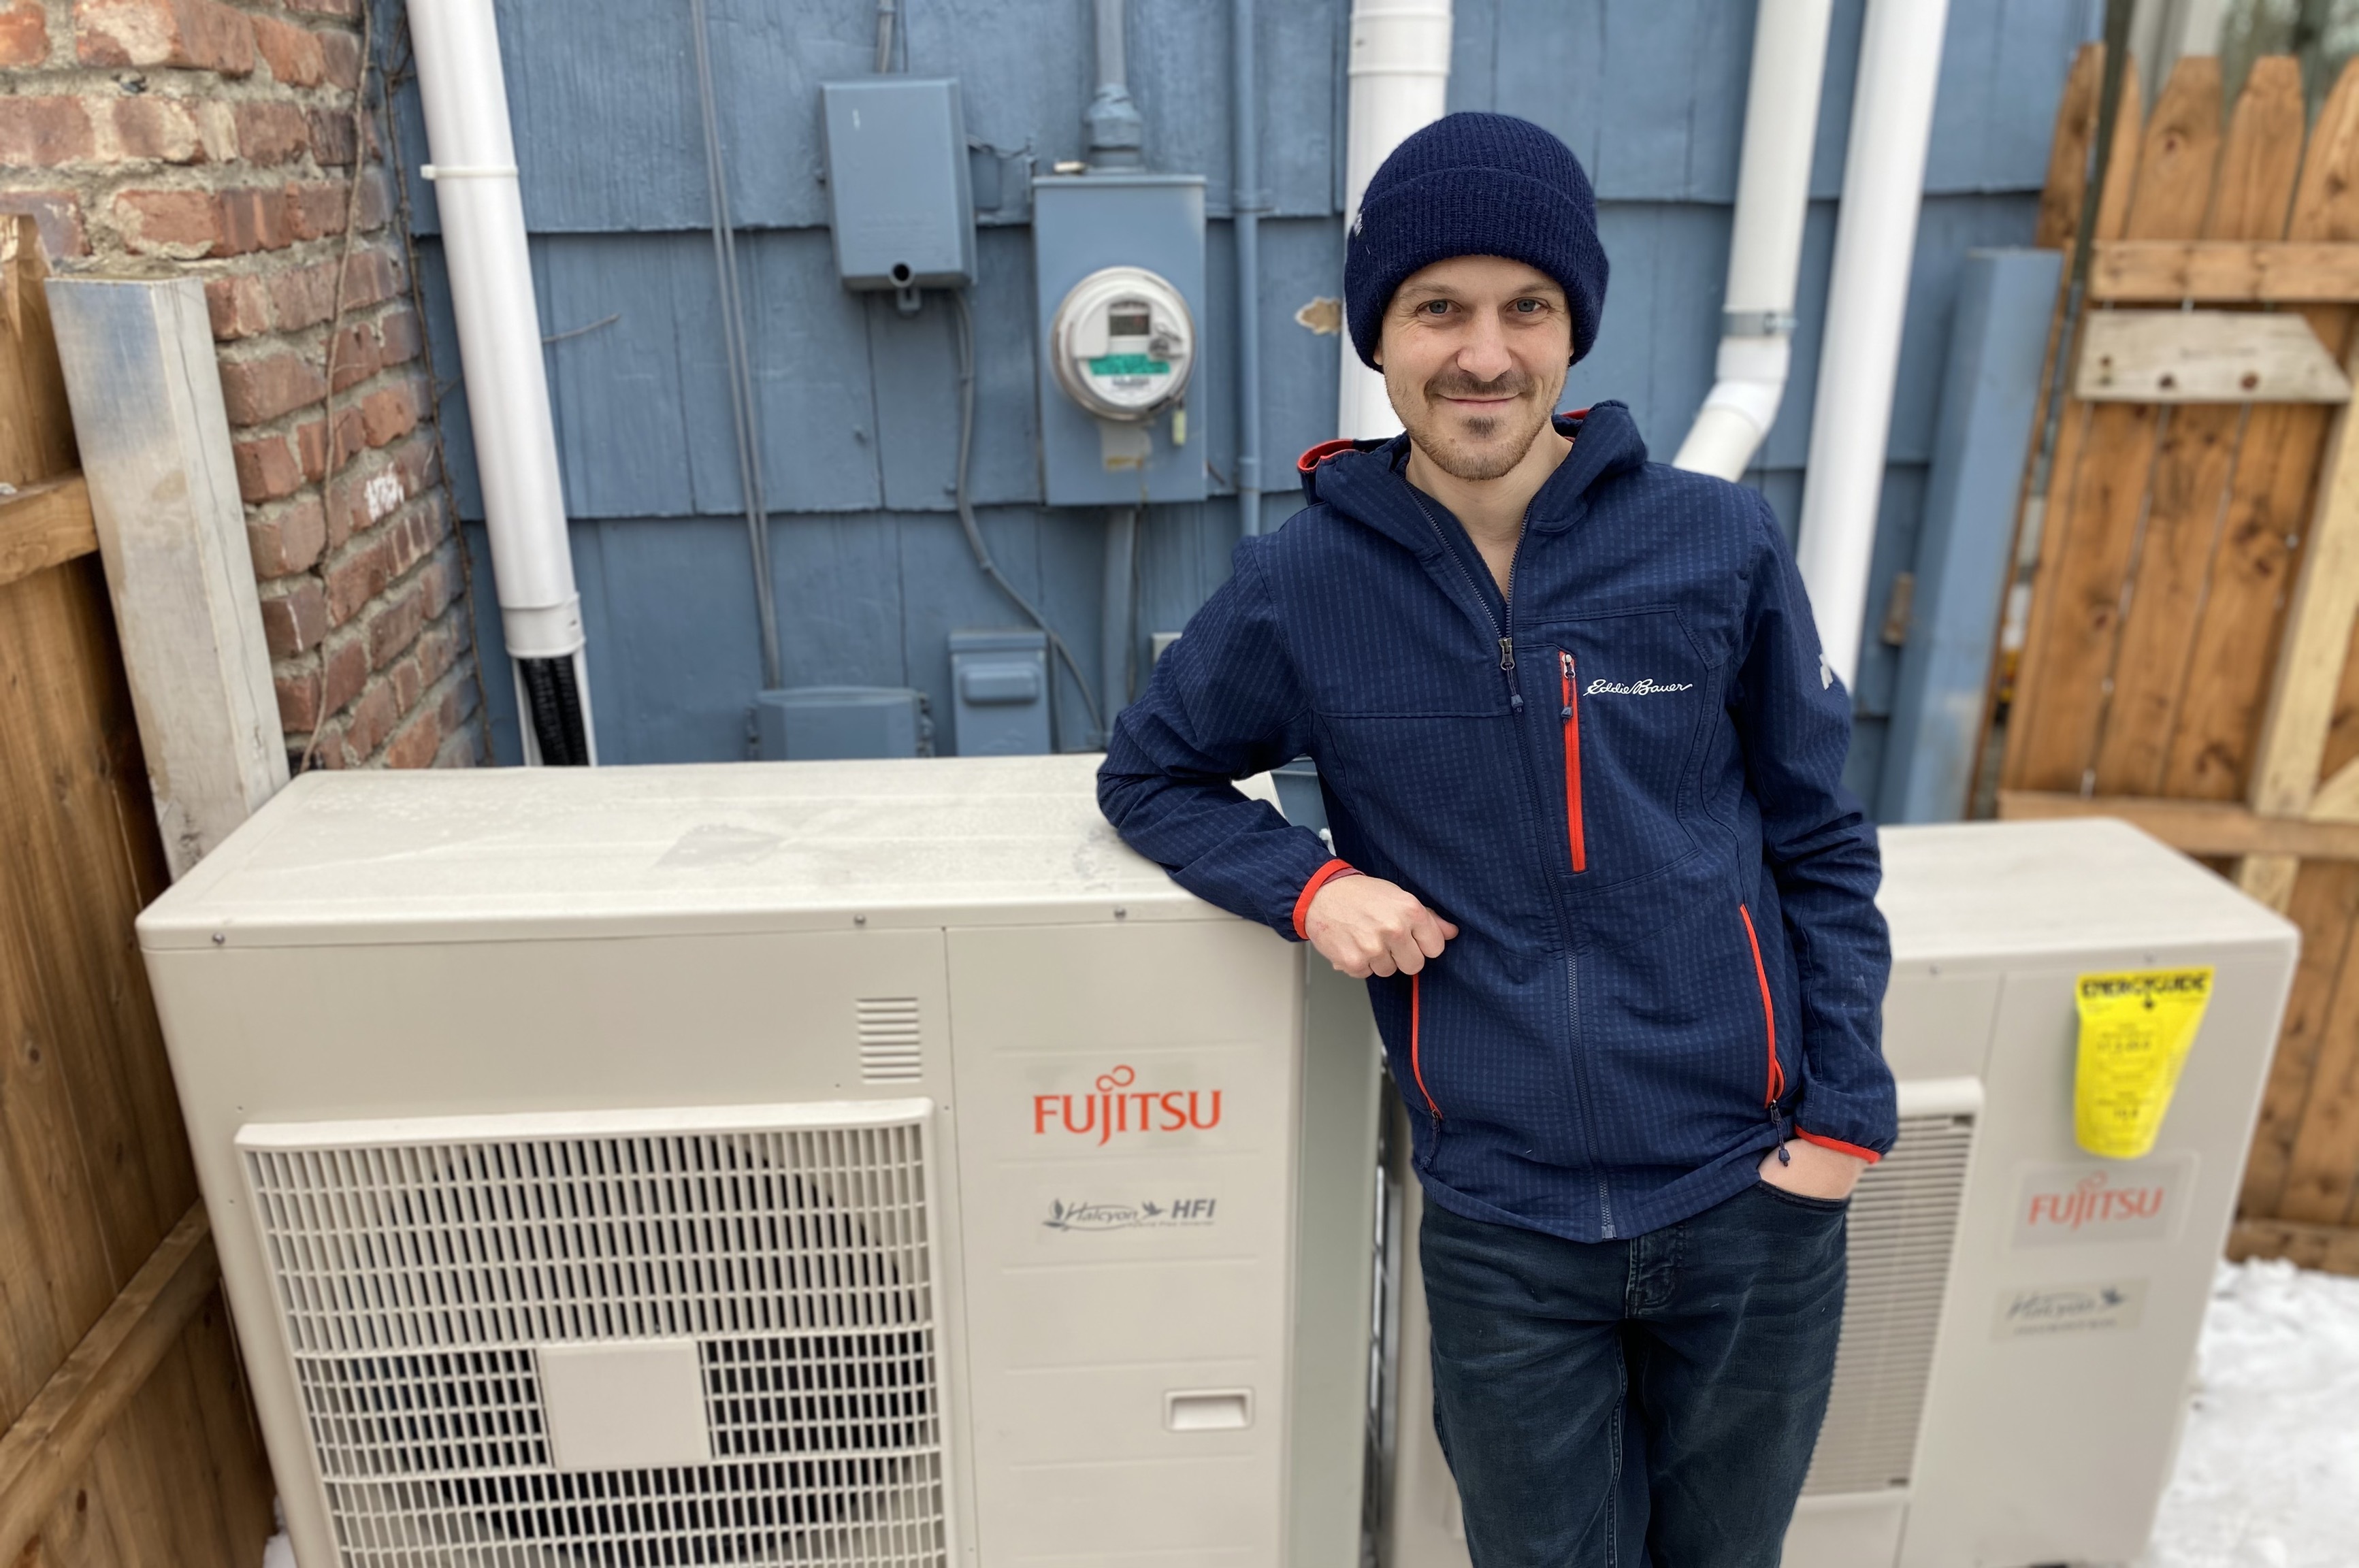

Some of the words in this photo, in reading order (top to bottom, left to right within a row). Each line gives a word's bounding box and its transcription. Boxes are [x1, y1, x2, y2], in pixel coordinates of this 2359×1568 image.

[1583, 679, 1633, 696] Eddie
[1633, 679, 1693, 696] Bauer
[1033, 1064, 1222, 1147] FUJITSU
[1064, 1202, 1139, 1223] Halcyon
[1171, 1198, 1217, 1220] HFI
[2028, 1171, 2165, 1232] FUJITSU
